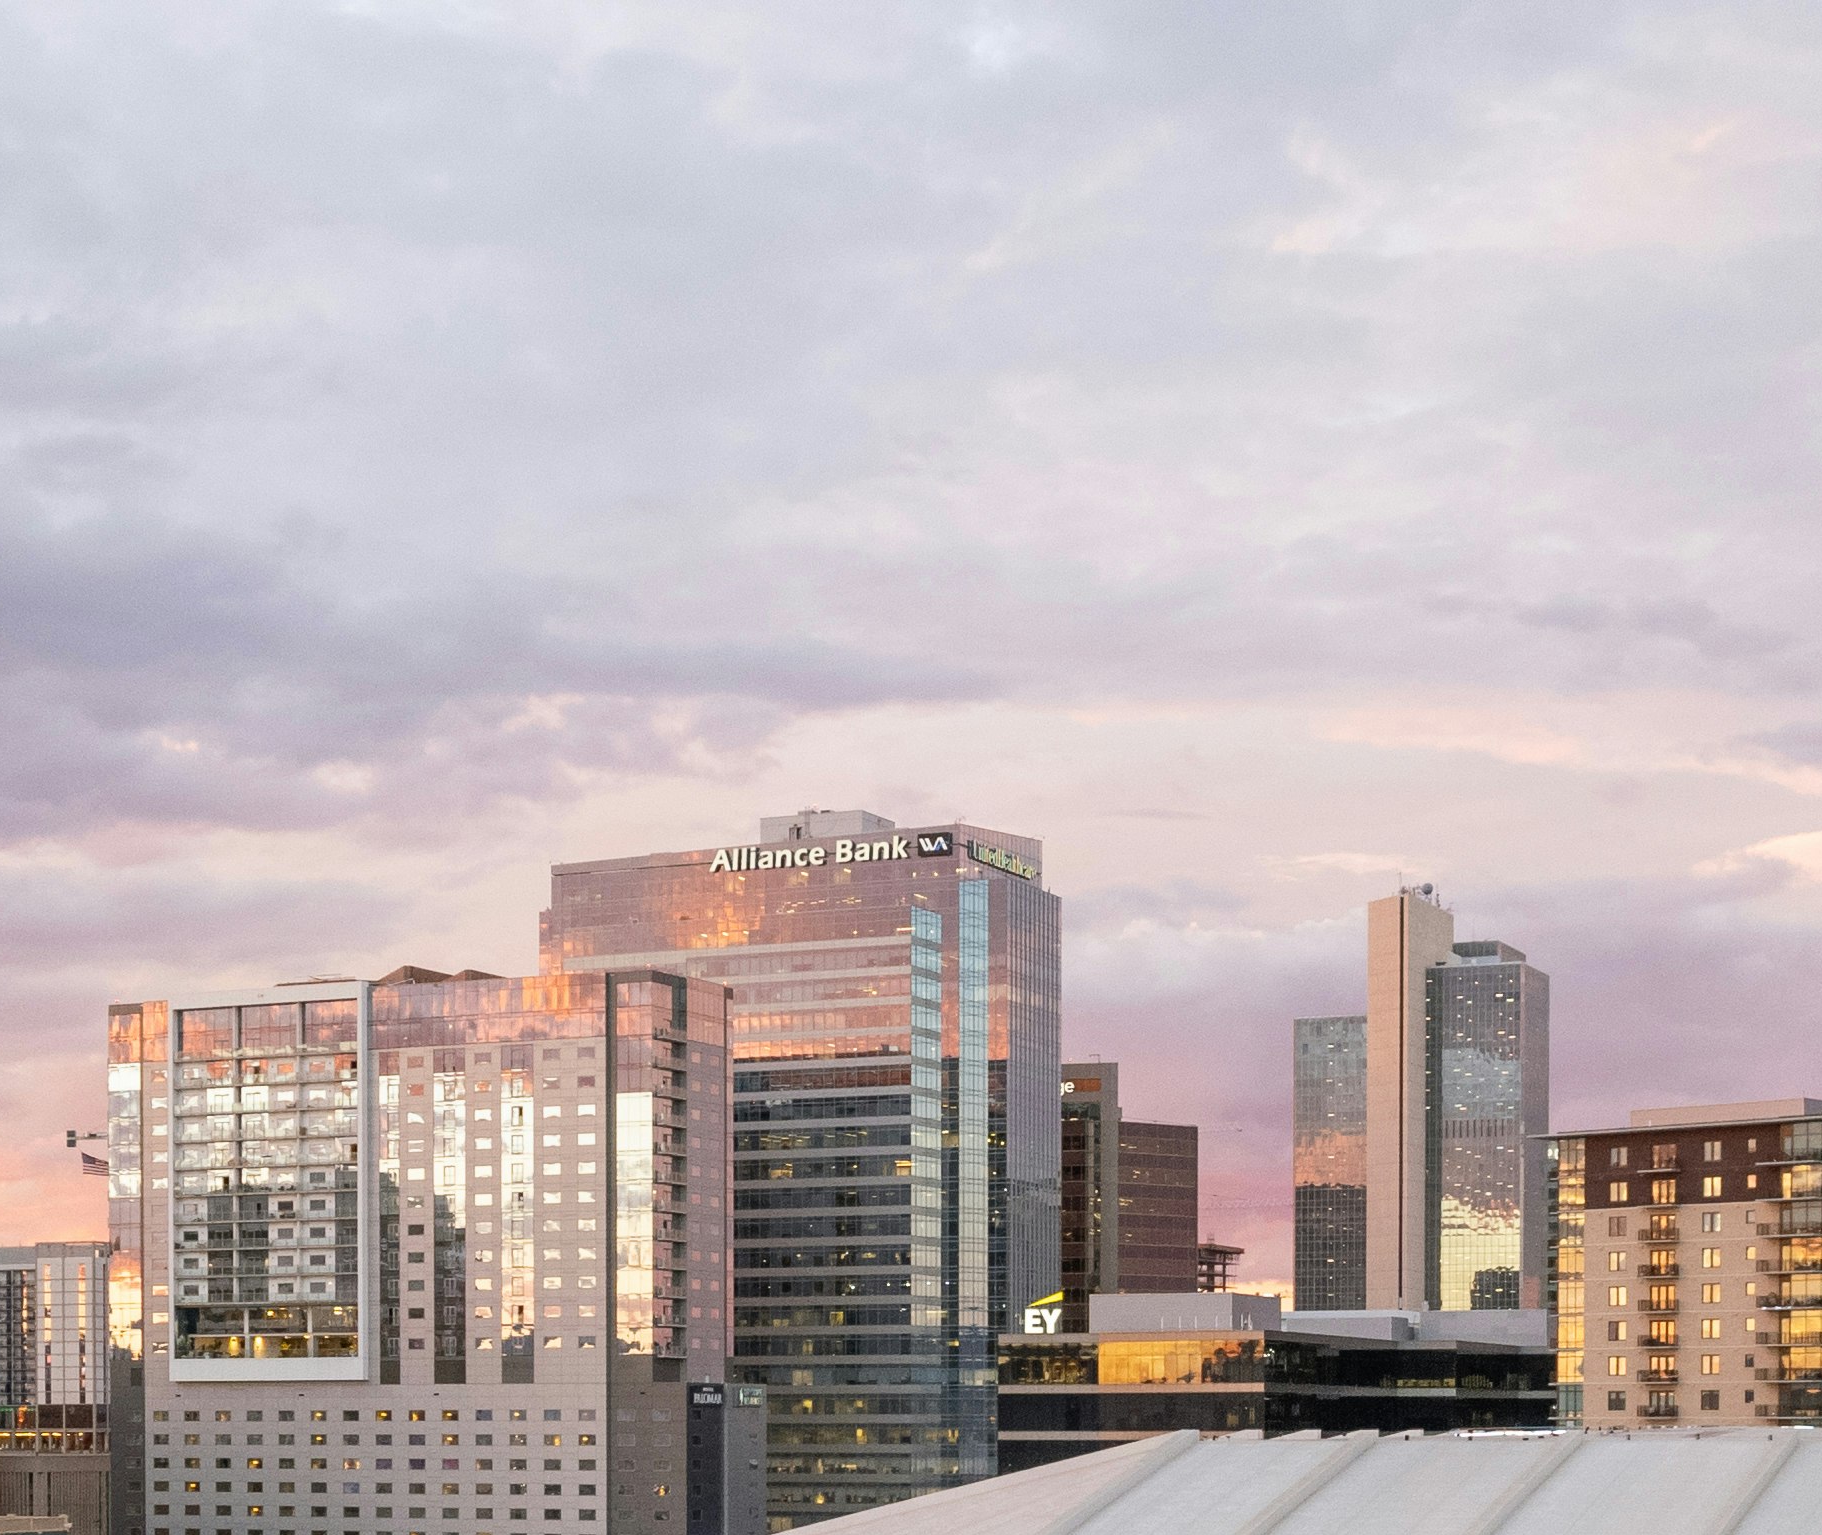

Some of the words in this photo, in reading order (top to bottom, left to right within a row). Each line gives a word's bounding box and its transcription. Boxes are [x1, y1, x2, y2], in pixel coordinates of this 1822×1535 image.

[709, 846, 826, 873] Alliance
[835, 835, 909, 863] Bank
[1024, 1308, 1062, 1334] EY
